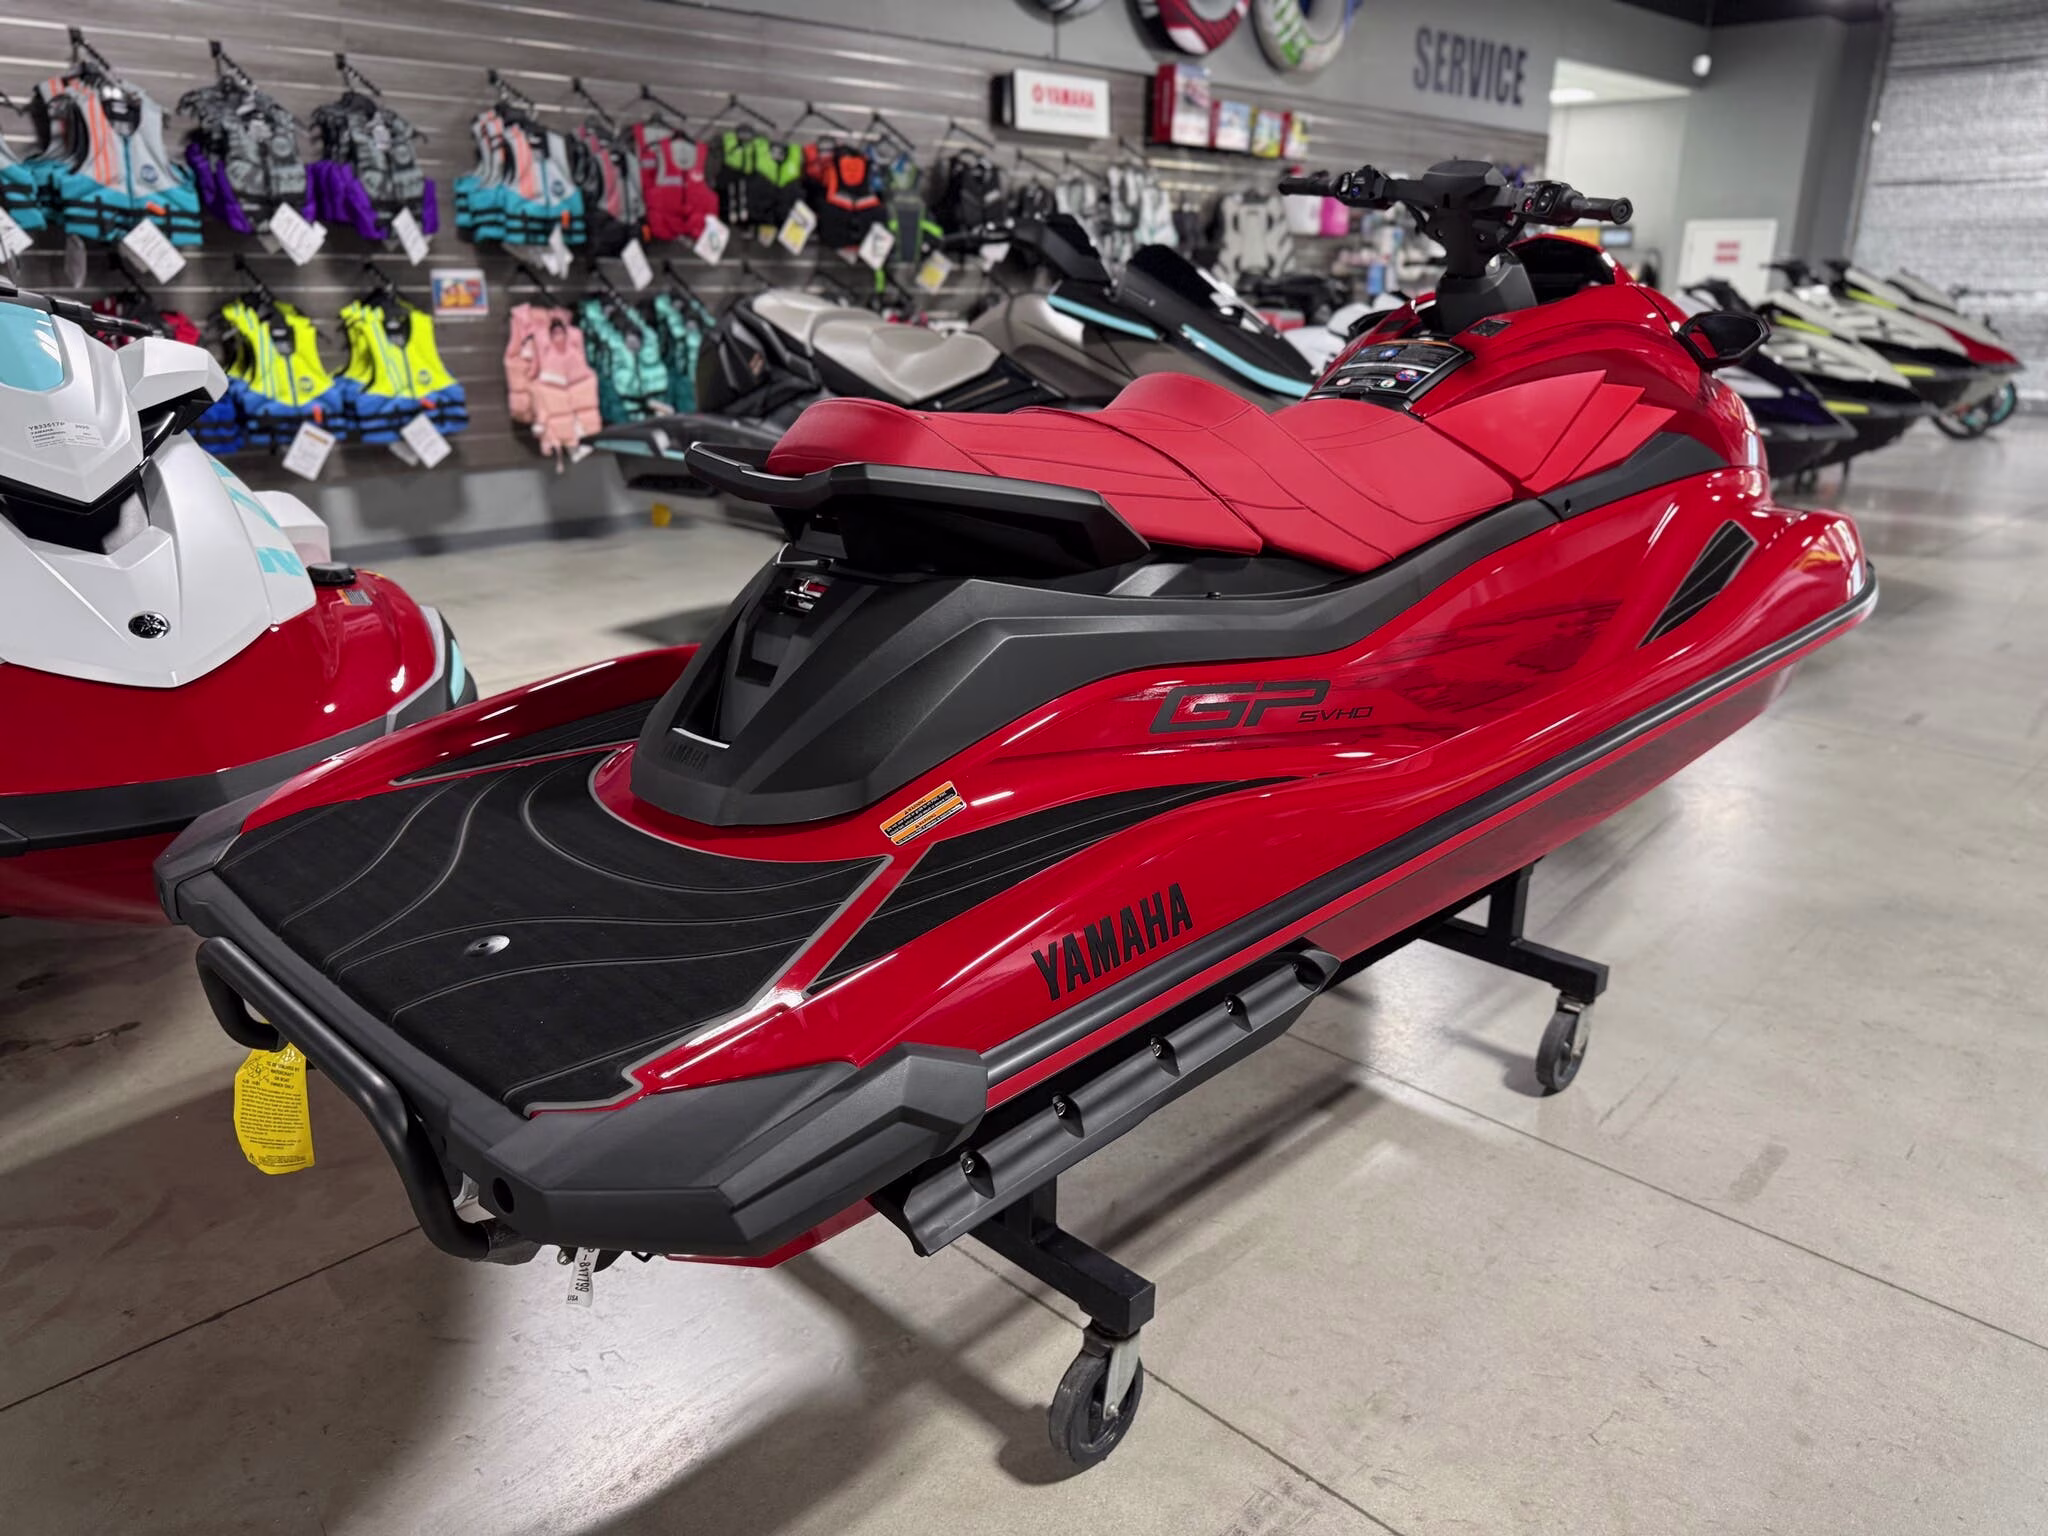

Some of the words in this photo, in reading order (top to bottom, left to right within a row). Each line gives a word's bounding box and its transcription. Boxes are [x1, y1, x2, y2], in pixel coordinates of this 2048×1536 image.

[1413, 26, 1527, 105] SERVICE
[1149, 679, 1331, 735] GP
[1298, 706, 1373, 723] SVHO
[1031, 882, 1193, 1001] YAMAHA
